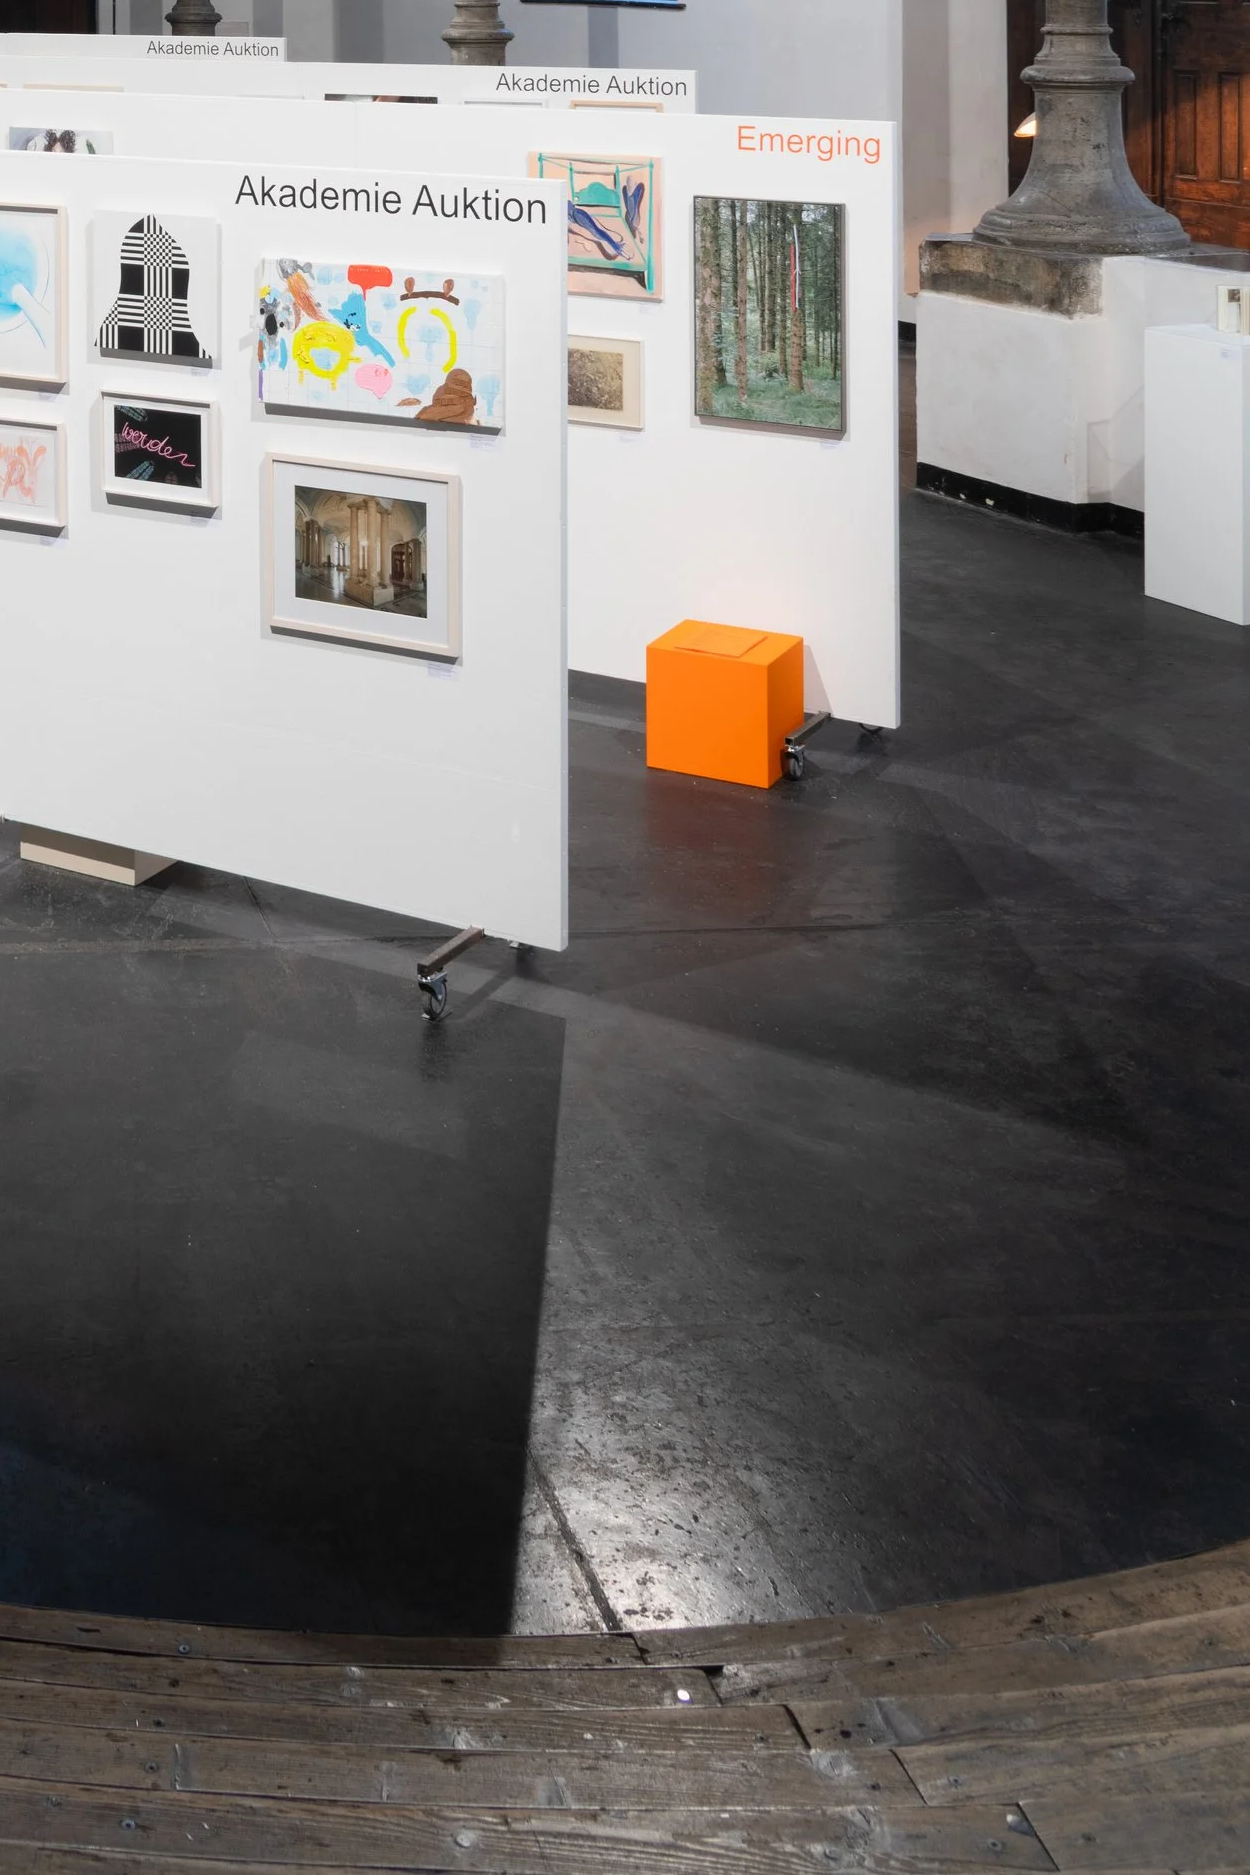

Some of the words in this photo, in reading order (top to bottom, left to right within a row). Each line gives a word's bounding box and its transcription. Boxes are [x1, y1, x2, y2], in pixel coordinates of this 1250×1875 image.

[146, 39, 221, 55] Akademie
[223, 41, 279, 57] Auktion
[495, 72, 600, 94] Akademie
[606, 75, 687, 97] Auktion
[737, 124, 882, 165] Emerging
[235, 175, 402, 214] Akademie
[412, 184, 547, 224] Auktion
